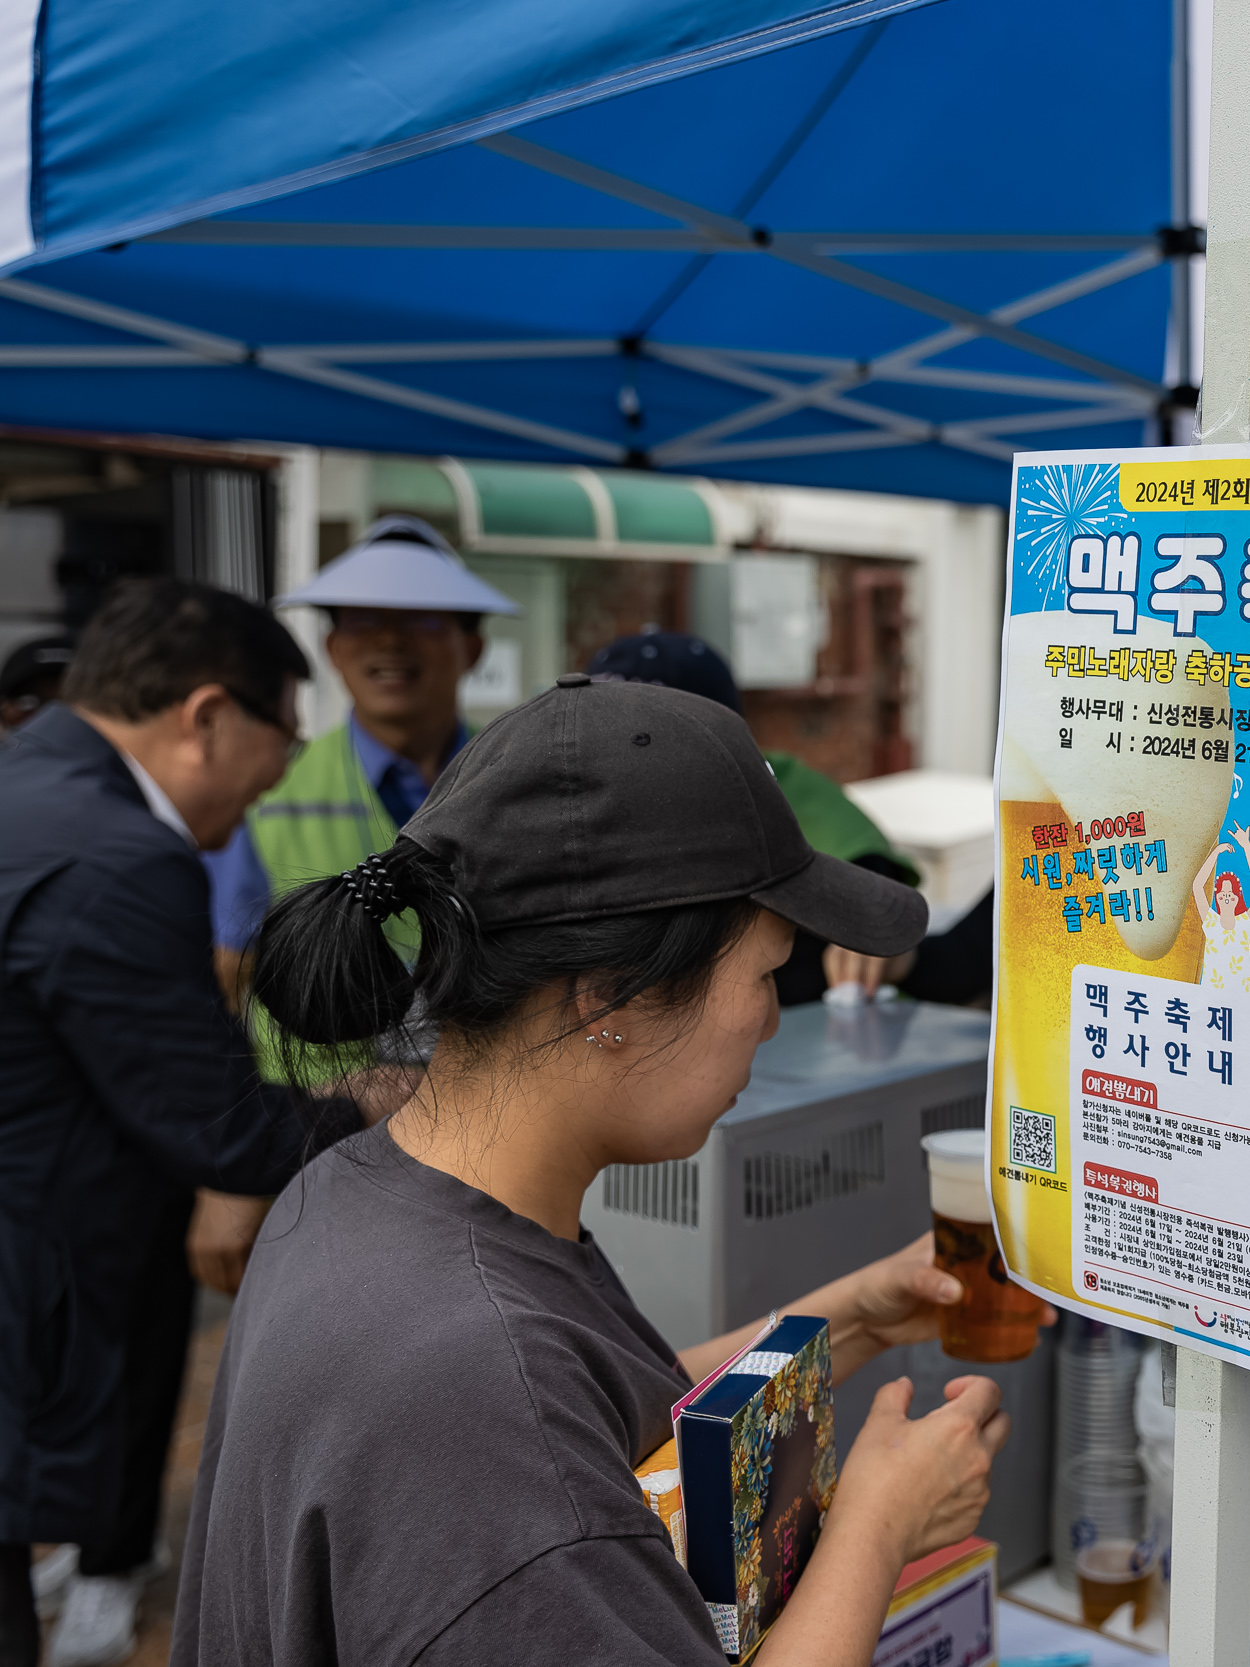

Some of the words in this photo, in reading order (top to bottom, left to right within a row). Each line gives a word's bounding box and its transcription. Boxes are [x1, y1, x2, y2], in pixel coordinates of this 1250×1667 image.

[1136, 479, 1195, 506] 2024년
[1203, 477, 1250, 505] 제2회
[1045, 645, 1177, 685] 주민노래자랑
[1061, 696, 1123, 723] 행사무대
[1059, 727, 1072, 749] 일
[1106, 731, 1121, 754] 시
[1142, 736, 1197, 761] 2024년
[1202, 738, 1229, 764] 6월
[1032, 823, 1068, 850] 한잔
[1075, 811, 1146, 846] 1,000원
[1020, 840, 1168, 890] 시원,짜릿하게
[1061, 886, 1155, 933] 즐겨라!!
[1085, 1074, 1154, 1105] 애견뽐내기
[1082, 1109, 1108, 1125] 본선참가
[1112, 1116, 1129, 1129] 5마리
[1133, 1121, 1172, 1140] 강아지에게는
[1207, 1139, 1221, 1151] 지급
[1083, 1098, 1121, 1117] 참가신청자는
[1155, 1115, 1161, 1126] 및
[1164, 1117, 1178, 1130] 해당
[1181, 1121, 1220, 1139] QR코드로도
[1083, 1120, 1109, 1135] 사진첨부
[1118, 1130, 1203, 1157] sinsung7543@gmail.com
[1083, 1131, 1109, 1146] 문의전화
[1118, 1140, 1173, 1161] 070-7543-7358
[999, 1166, 1036, 1186] 애견뽐내기
[1040, 1176, 1067, 1192] QR코드
[1086, 1168, 1158, 1199] 즉석복권행사
[1084, 1201, 1110, 1217] 배부기간
[1119, 1210, 1142, 1225] 2024년
[1145, 1217, 1156, 1229] 6월
[1159, 1221, 1172, 1234] 17일
[1185, 1229, 1208, 1244] 2024년
[1212, 1236, 1223, 1248] 6월
[1227, 1240, 1242, 1253] 21일
[1130, 1202, 1183, 1226] 신성전통시장전용
[1186, 1217, 1213, 1235] 즉석복권
[1084, 1212, 1110, 1227] 사용기간
[1119, 1221, 1142, 1236] 2024년
[1145, 1228, 1156, 1240] 6월
[1159, 1232, 1172, 1245] 17일
[1185, 1239, 1208, 1255] 2024년
[1212, 1247, 1223, 1260] 6월
[1227, 1251, 1243, 1265] 23일
[1084, 1223, 1091, 1233] 조
[1104, 1227, 1110, 1238] 건
[1120, 1232, 1139, 1246] 시장내
[1143, 1238, 1202, 1265] 상인회가입점포에서
[784, 1528, 793, 1565] SET
